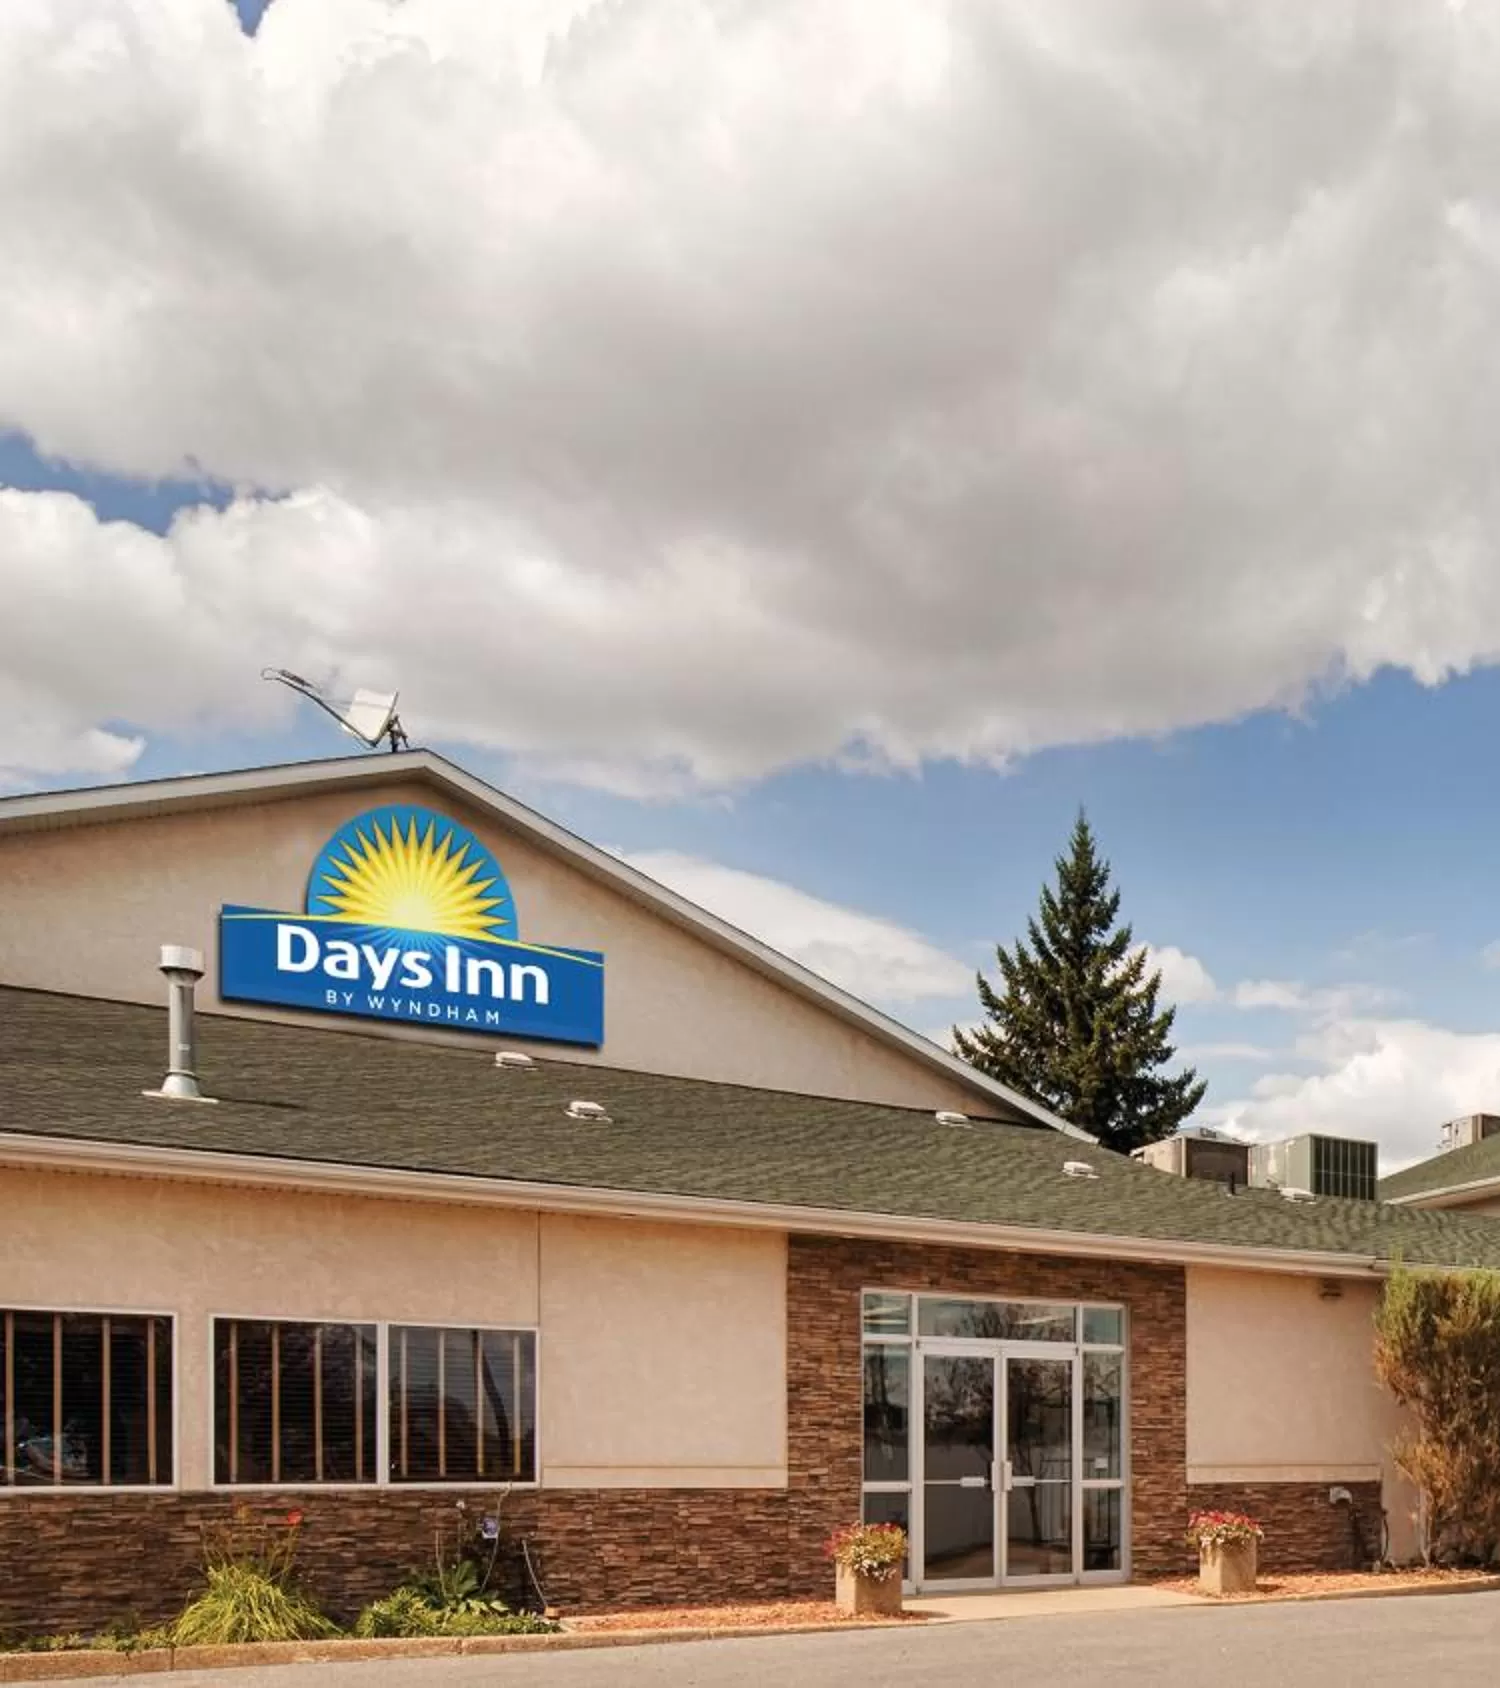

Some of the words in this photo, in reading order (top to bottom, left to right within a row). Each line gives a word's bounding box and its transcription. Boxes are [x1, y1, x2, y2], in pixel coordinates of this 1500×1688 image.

[277, 923, 433, 990] Days
[445, 945, 549, 1005] Inn
[326, 989, 353, 1006] BY
[368, 994, 499, 1024] WYNDHAM
